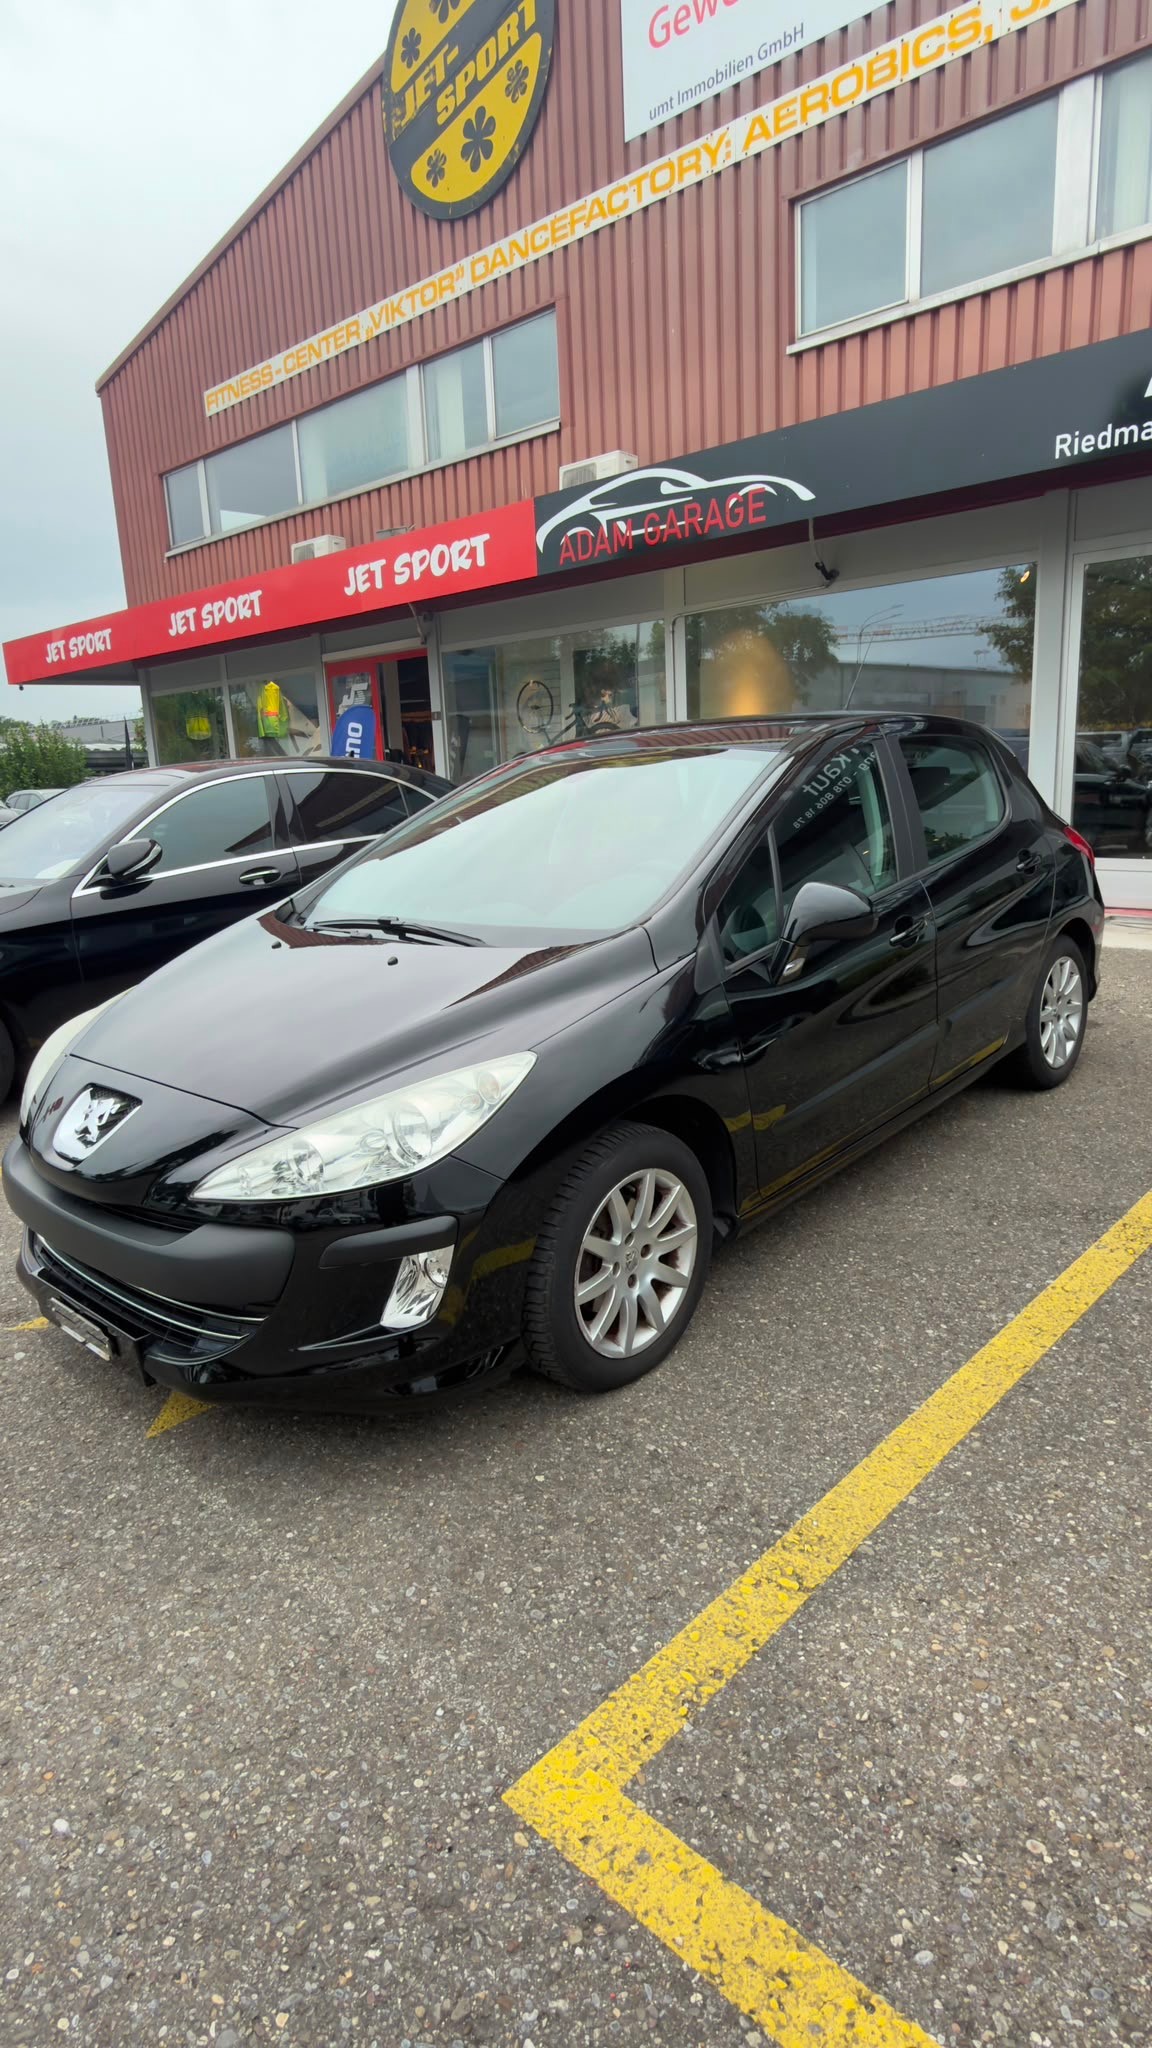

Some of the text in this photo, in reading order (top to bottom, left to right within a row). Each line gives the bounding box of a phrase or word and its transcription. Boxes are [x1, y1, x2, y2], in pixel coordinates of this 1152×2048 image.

[648, 0, 739, 49] Gew
[436, 0, 536, 126] SPORT
[649, 22, 804, 121] umt Immobilien GmbH
[470, 130, 732, 284] DANCEFACTORY:
[741, 5, 993, 152] AEROBICS,
[559, 487, 767, 566] ADAM GARAGE
[343, 533, 491, 597] JET SPORT
[45, 628, 112, 664] JET SPORT
[168, 589, 263, 637] JET SPORT
